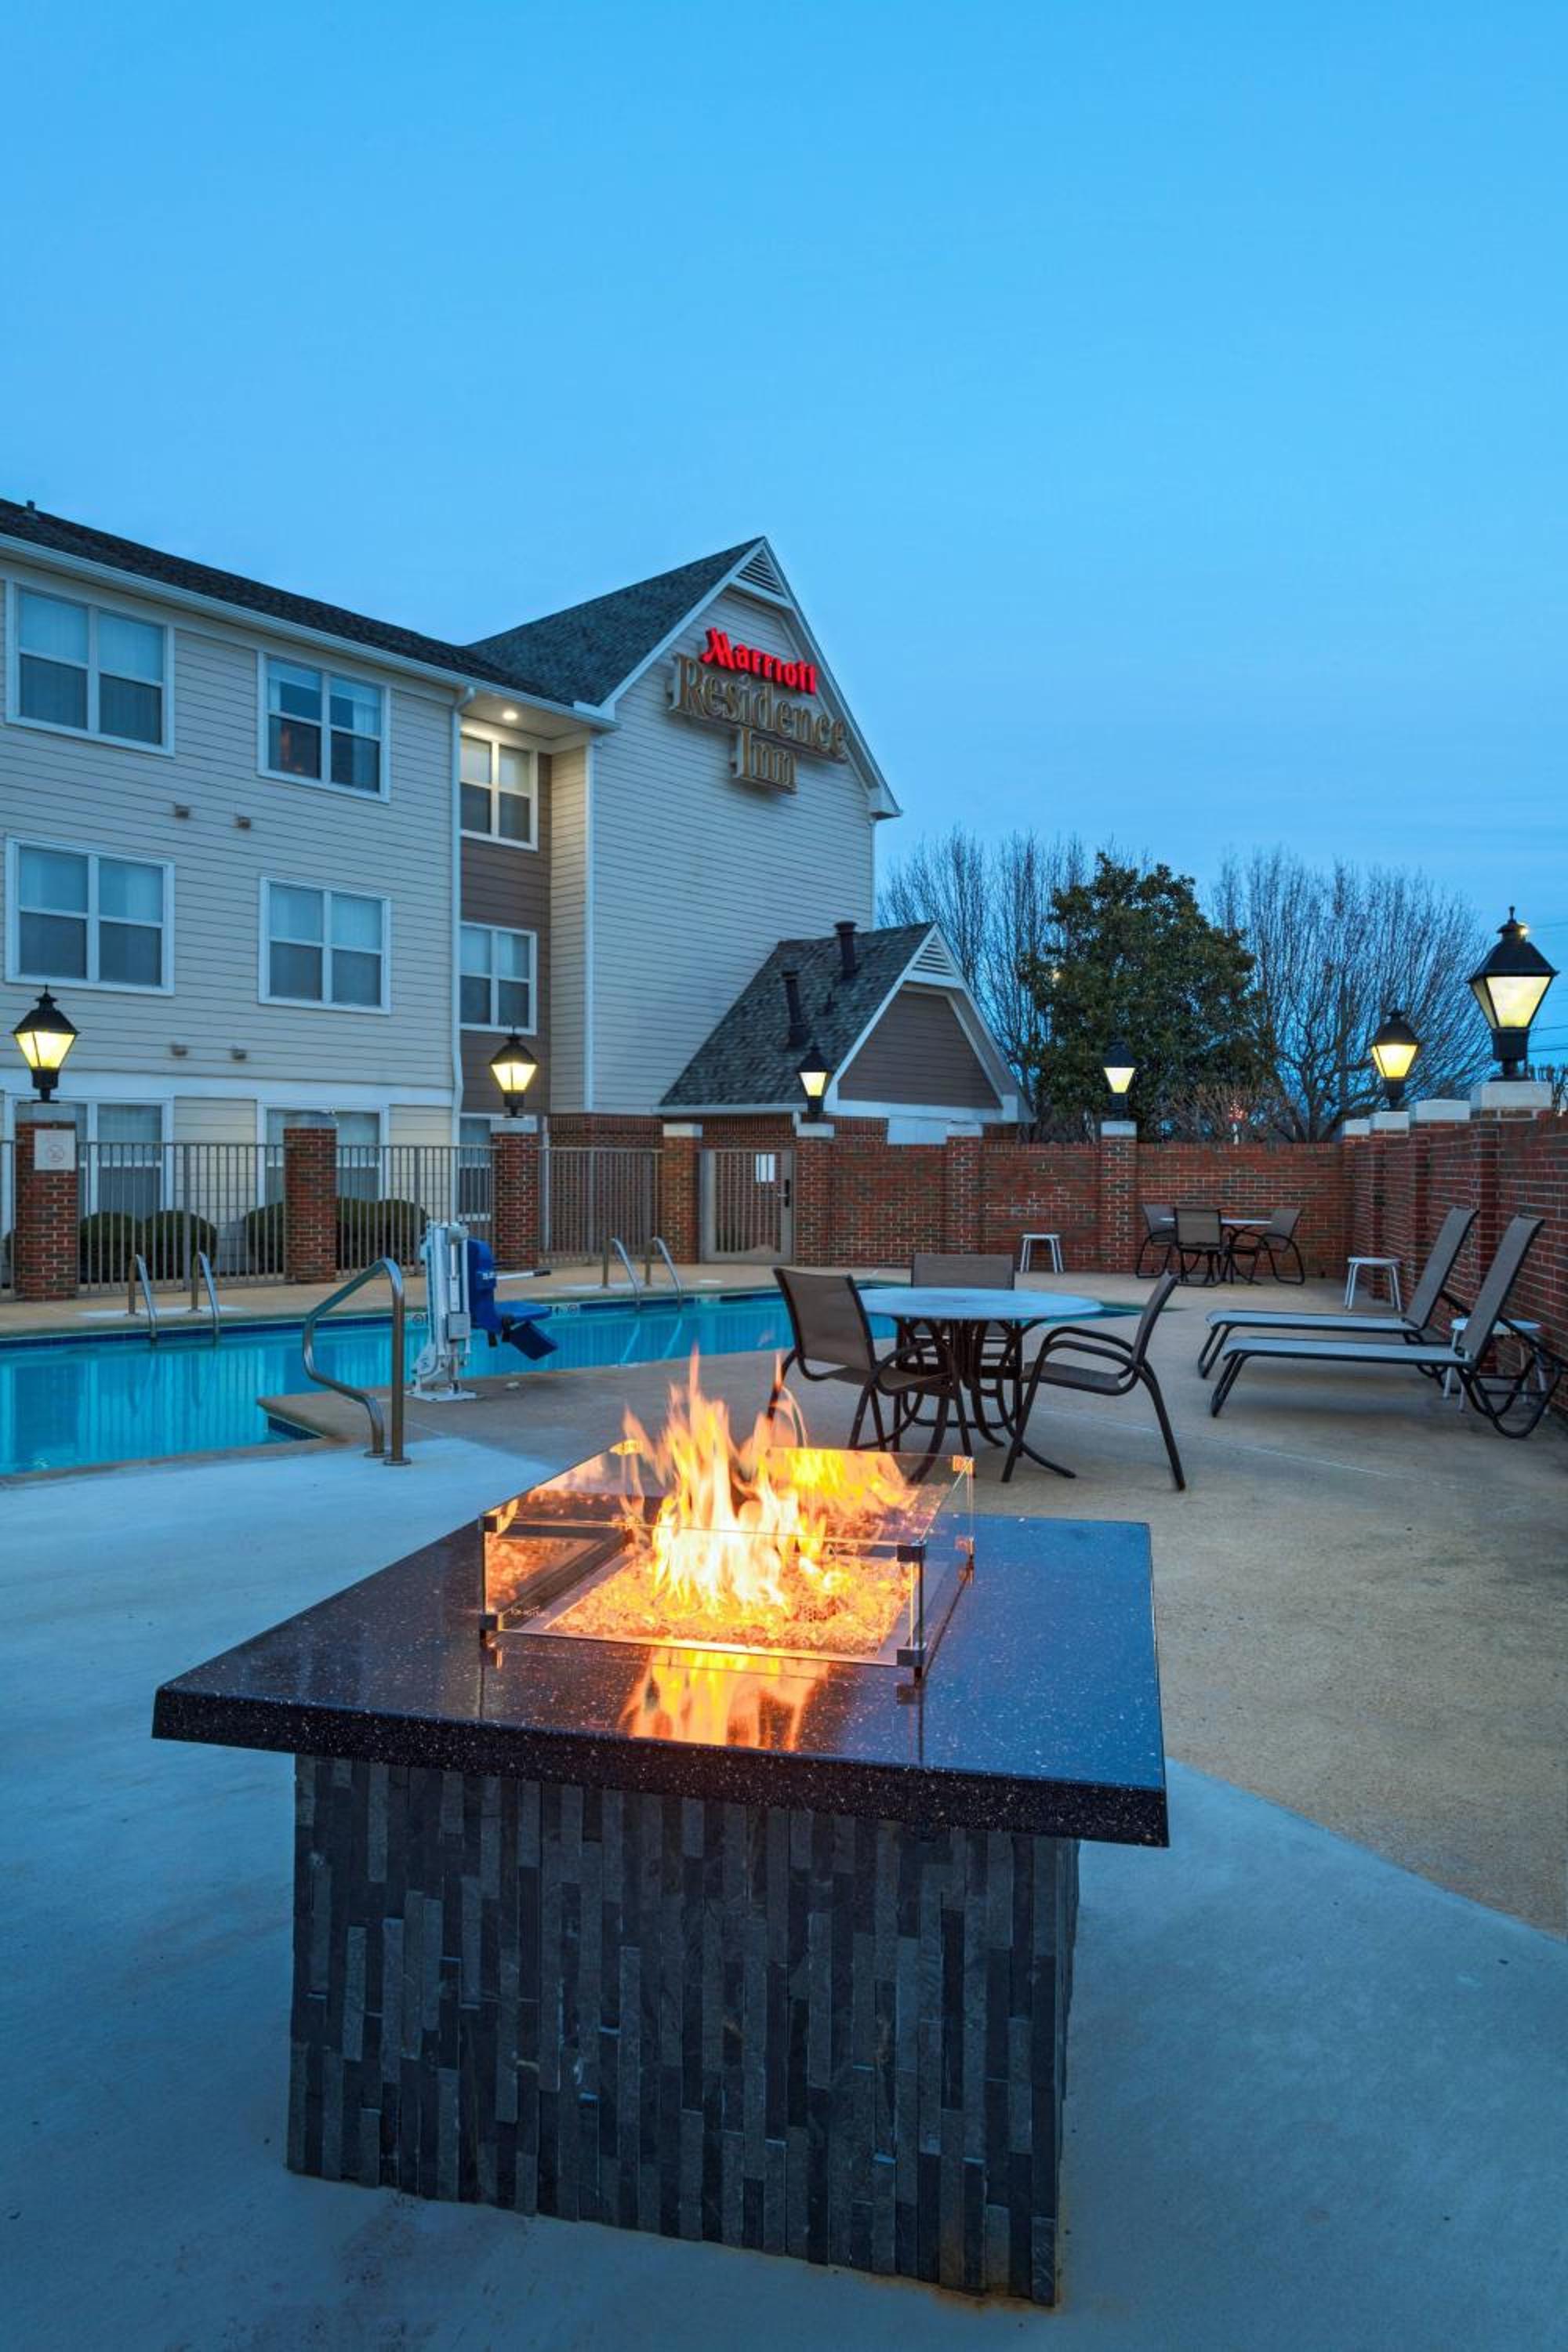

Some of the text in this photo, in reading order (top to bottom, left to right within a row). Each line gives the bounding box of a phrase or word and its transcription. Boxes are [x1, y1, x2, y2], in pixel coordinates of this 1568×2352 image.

[700, 626, 816, 695] Marriott
[670, 653, 846, 755] Residence
[734, 727, 797, 786] Inn
